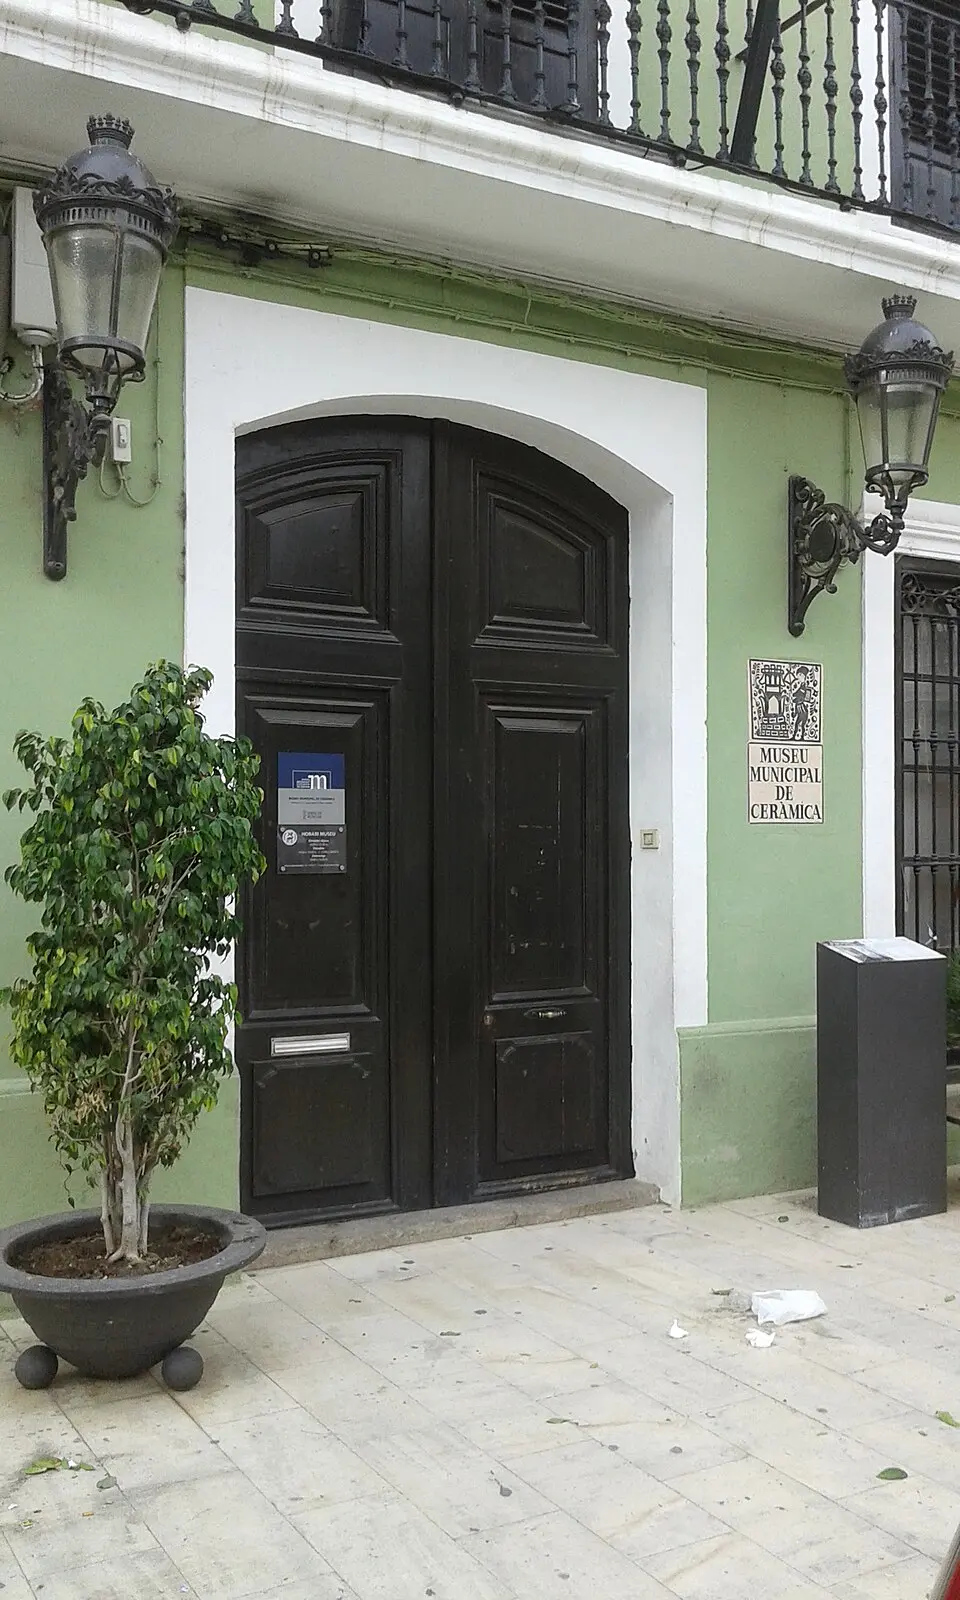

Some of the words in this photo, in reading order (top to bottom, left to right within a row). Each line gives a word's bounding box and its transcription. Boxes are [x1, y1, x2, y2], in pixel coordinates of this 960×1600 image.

[760, 747, 809, 764] MUSEU
[750, 766, 822, 783] MUNICIPAL
[775, 785, 794, 801] DE
[751, 801, 822, 820] CERÀMICA
